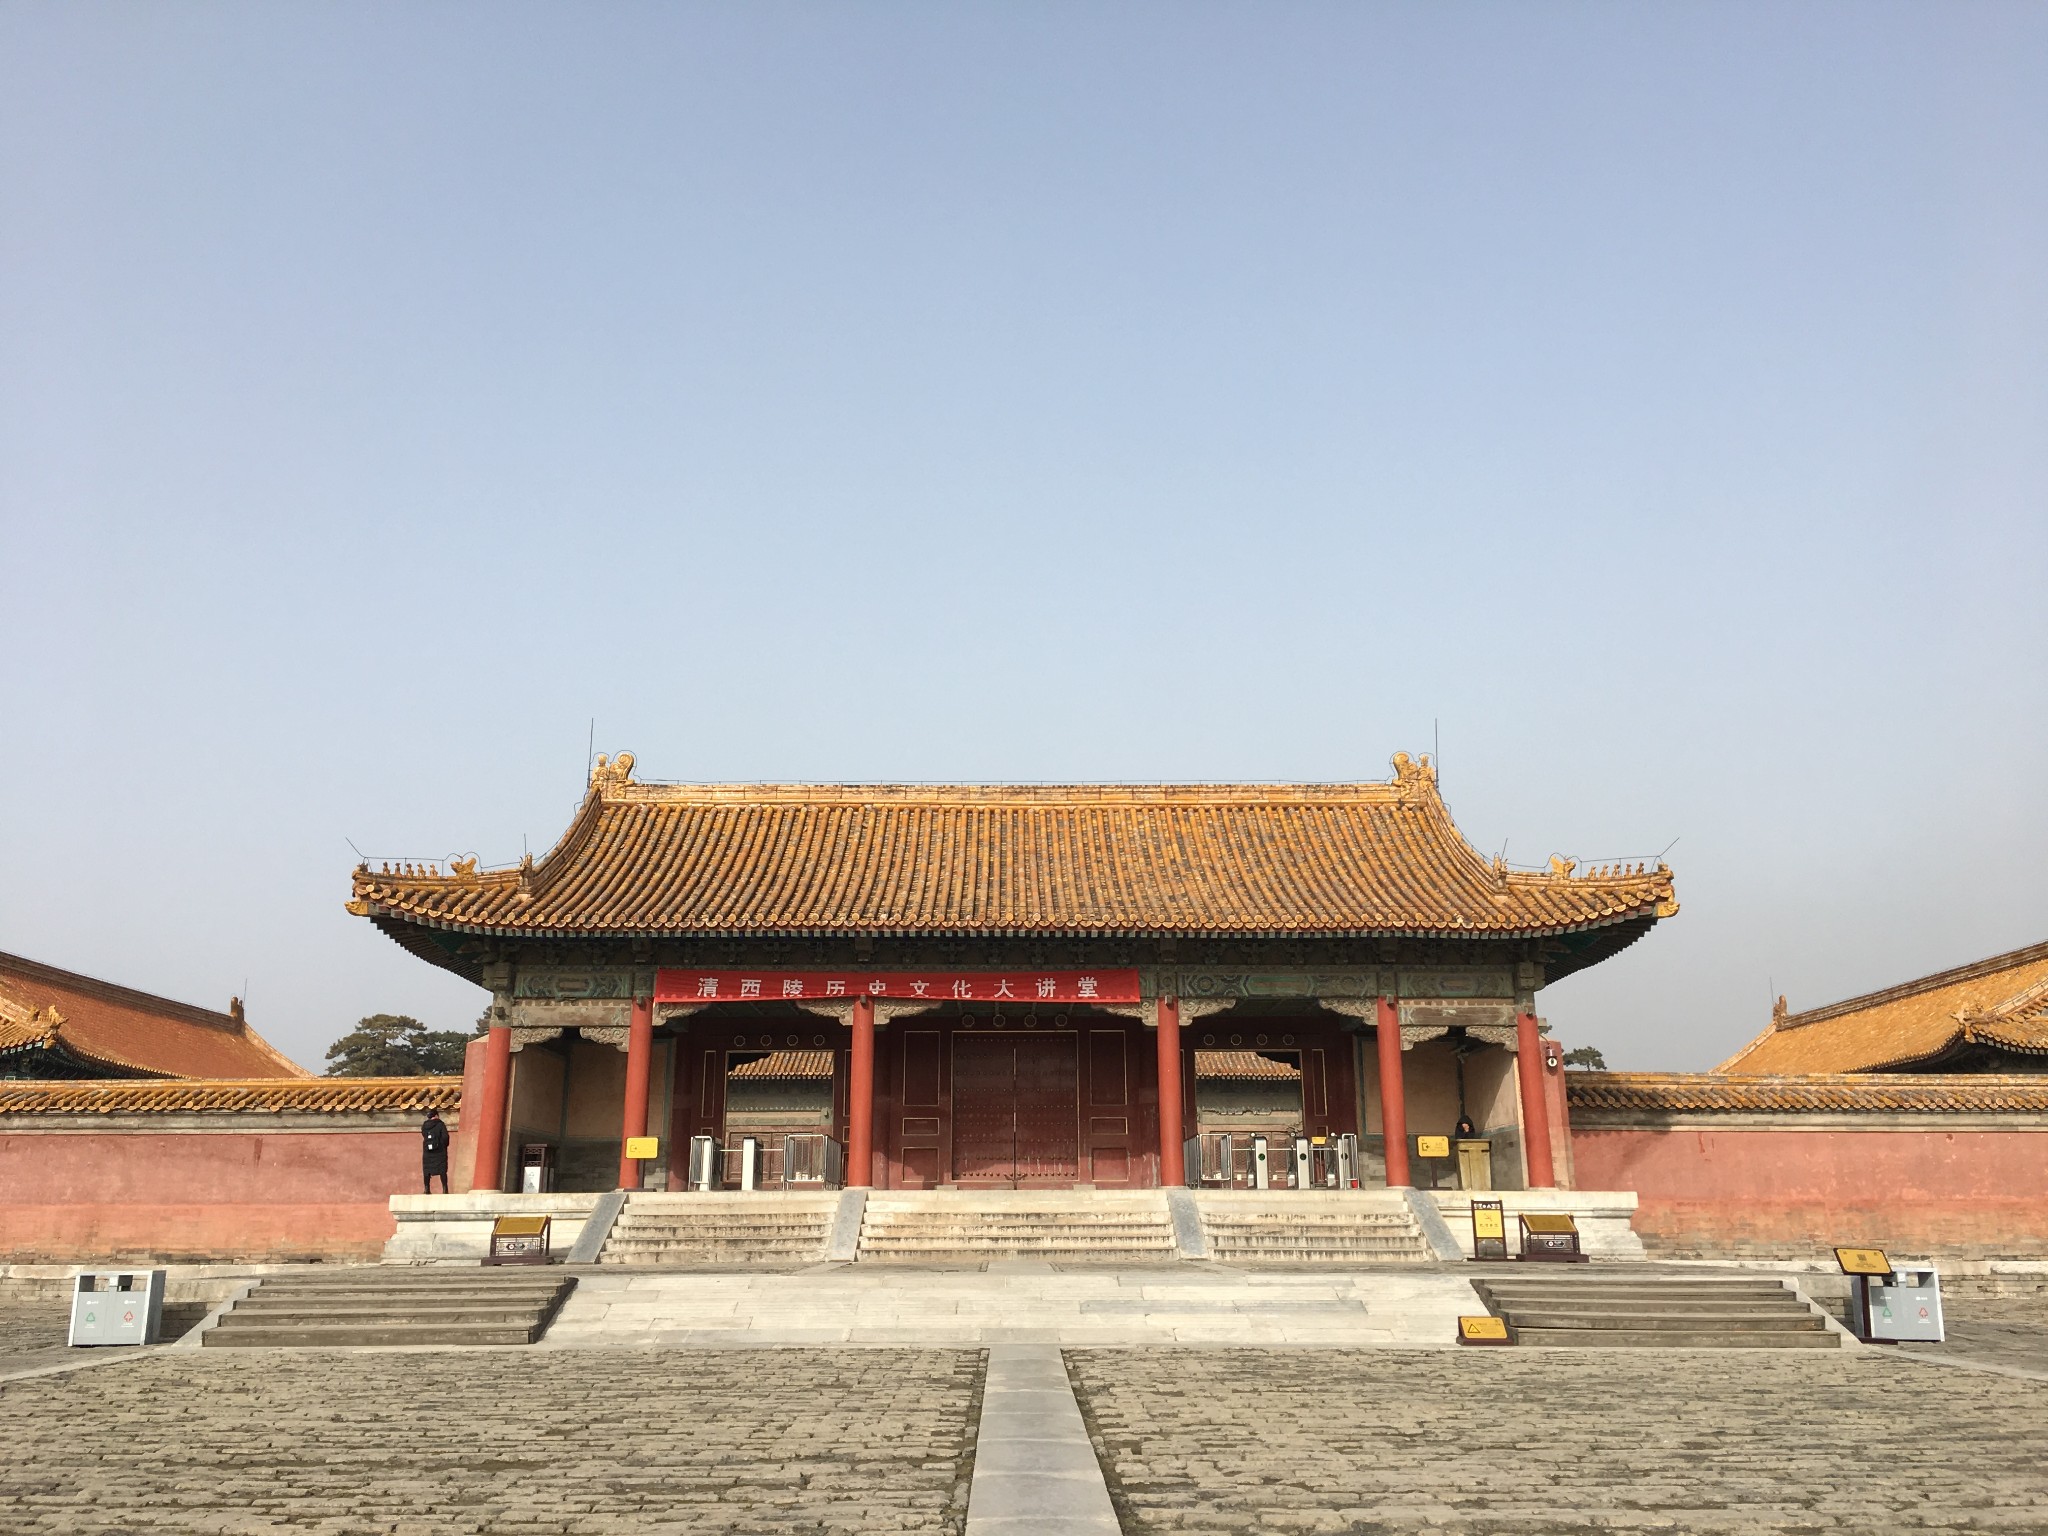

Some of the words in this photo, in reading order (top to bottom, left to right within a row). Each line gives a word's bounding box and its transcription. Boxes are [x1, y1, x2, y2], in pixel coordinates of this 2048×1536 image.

[697, 976, 1098, 998] 清西陵历史文化大讲堂
